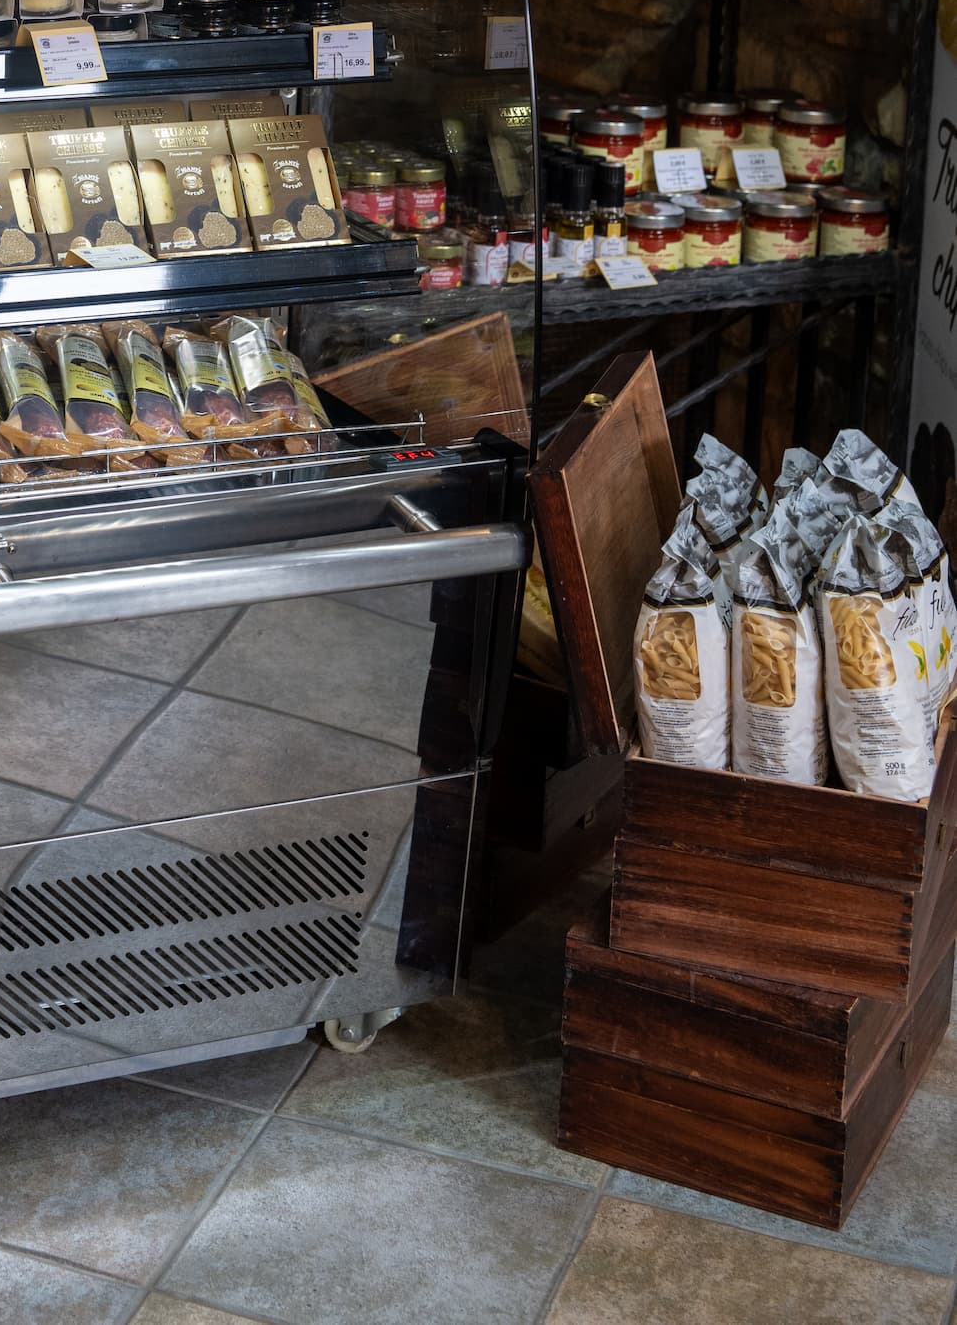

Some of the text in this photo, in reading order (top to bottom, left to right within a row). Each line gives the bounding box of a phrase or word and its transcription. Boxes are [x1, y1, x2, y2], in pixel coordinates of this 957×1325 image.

[76, 61, 94, 71] 9,99
[344, 58, 365, 68] 16,99
[153, 125, 210, 138] TRUFFLE
[256, 131, 304, 143] CHEESE
[49, 132, 107, 146] TRUFFLE
[159, 136, 207, 149] CHEESE
[55, 142, 105, 156] CHEESE
[885, 761, 900, 770] 500
